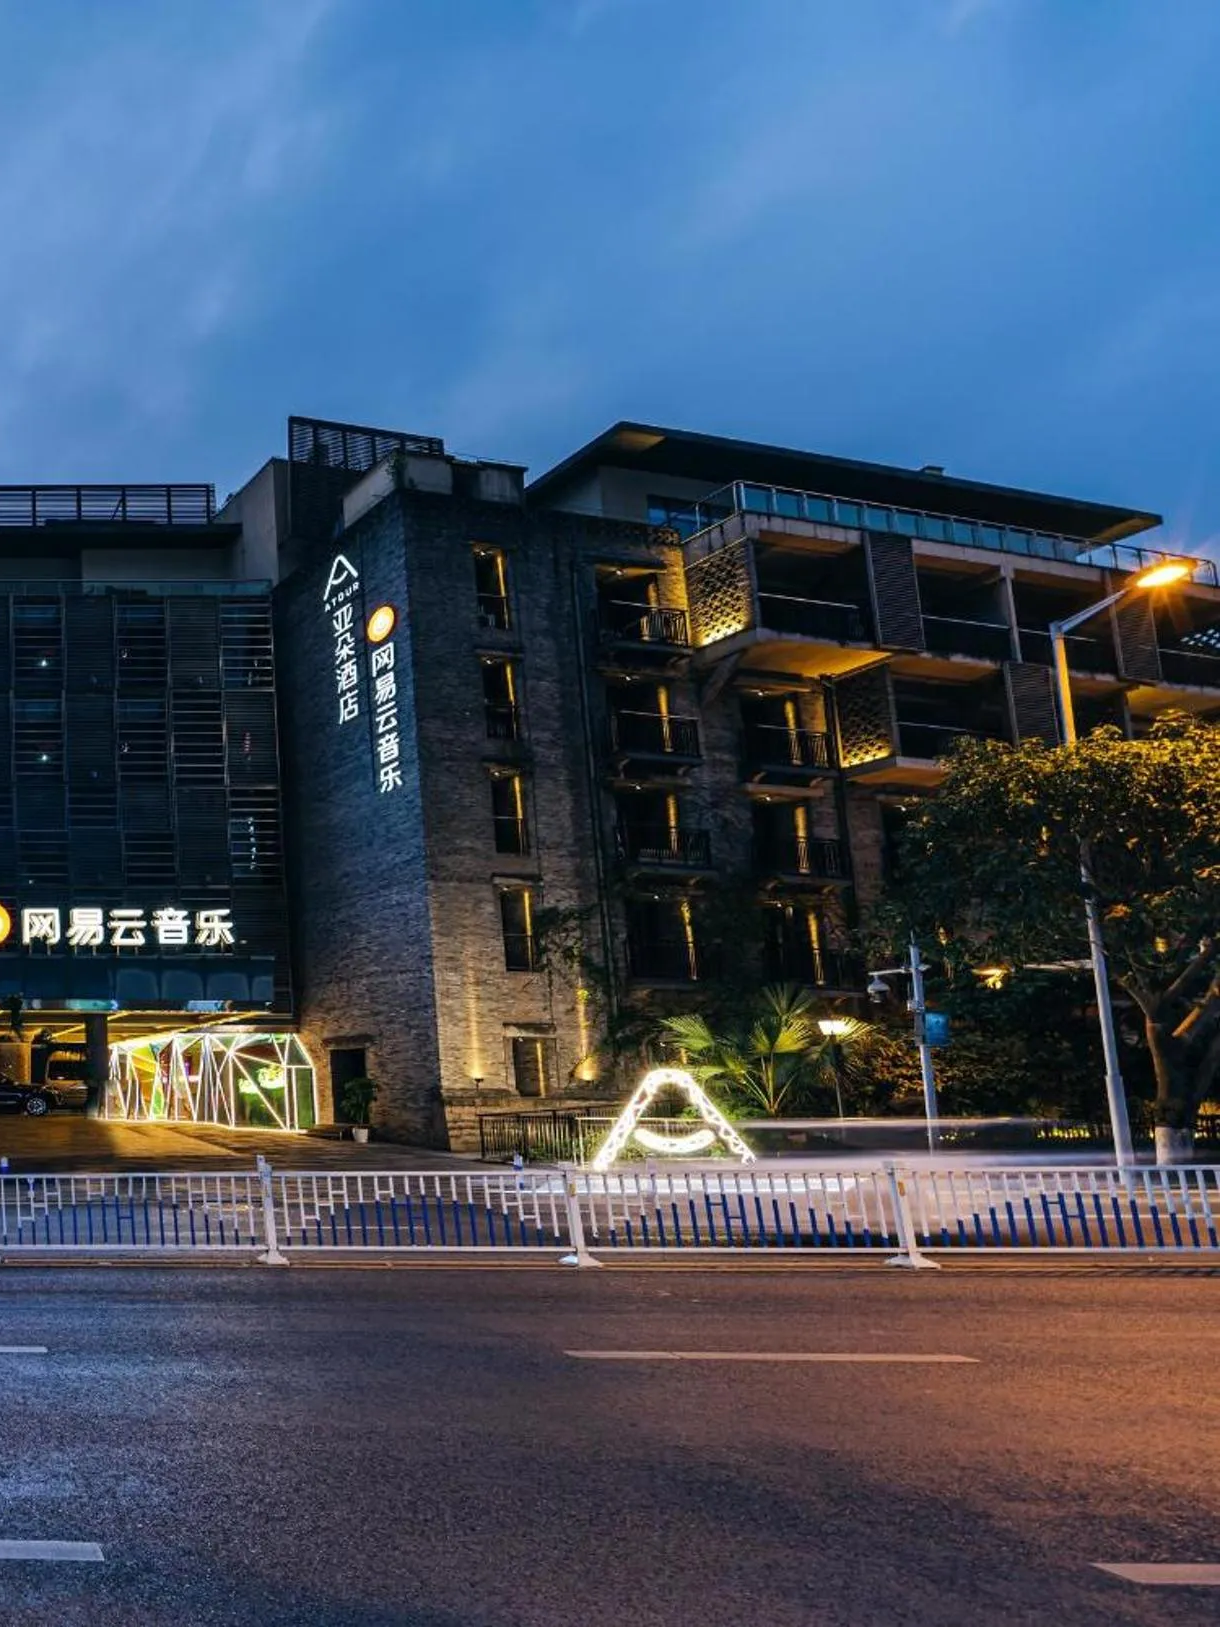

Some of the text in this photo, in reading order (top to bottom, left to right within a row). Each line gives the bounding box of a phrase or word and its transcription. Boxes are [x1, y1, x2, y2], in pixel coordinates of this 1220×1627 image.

[324, 582, 360, 613] ATOUR
[332, 603, 359, 725] 亚朵酒店
[371, 642, 403, 793] 网易云音乐
[21, 906, 236, 947] 网易云音乐
